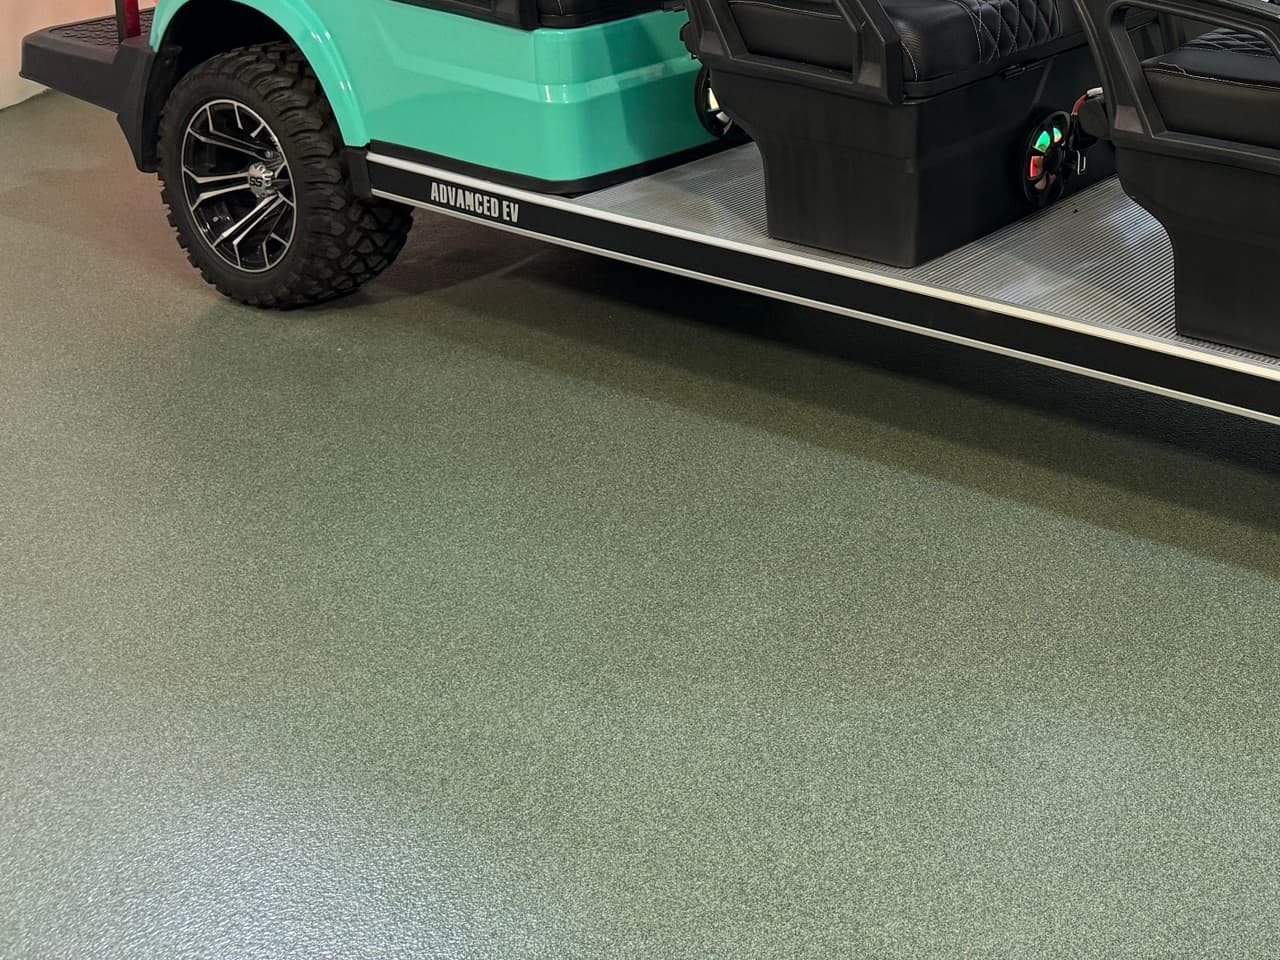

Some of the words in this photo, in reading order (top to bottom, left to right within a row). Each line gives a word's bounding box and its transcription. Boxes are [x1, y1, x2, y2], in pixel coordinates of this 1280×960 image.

[249, 177, 262, 187] SS
[431, 182, 499, 218] ADVANCED
[502, 200, 519, 223] EV
